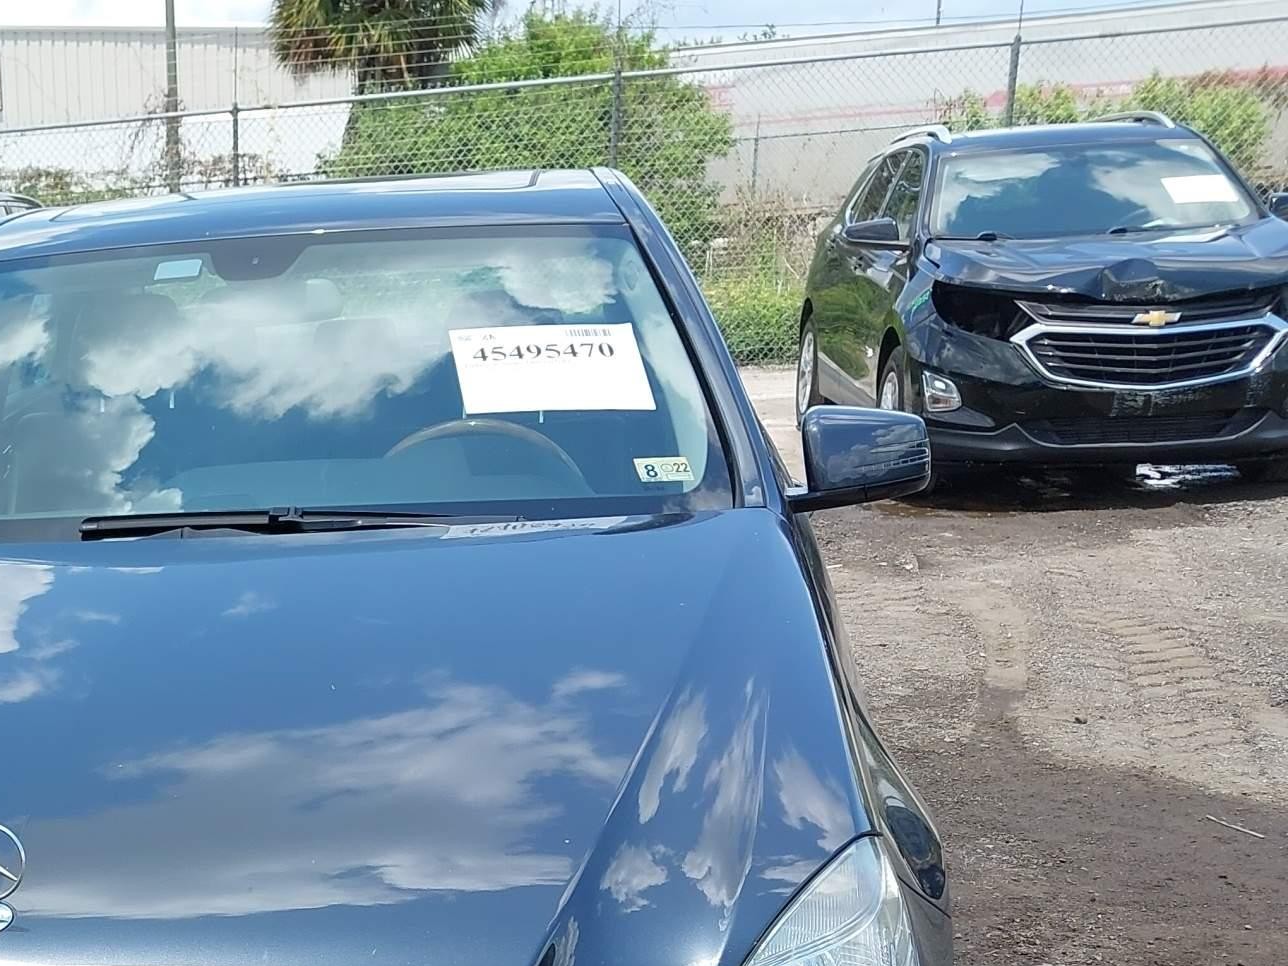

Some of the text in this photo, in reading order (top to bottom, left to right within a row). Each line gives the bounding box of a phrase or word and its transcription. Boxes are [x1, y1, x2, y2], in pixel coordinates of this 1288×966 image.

[472, 342, 615, 361] 45495470
[644, 462, 690, 478] 8 22
